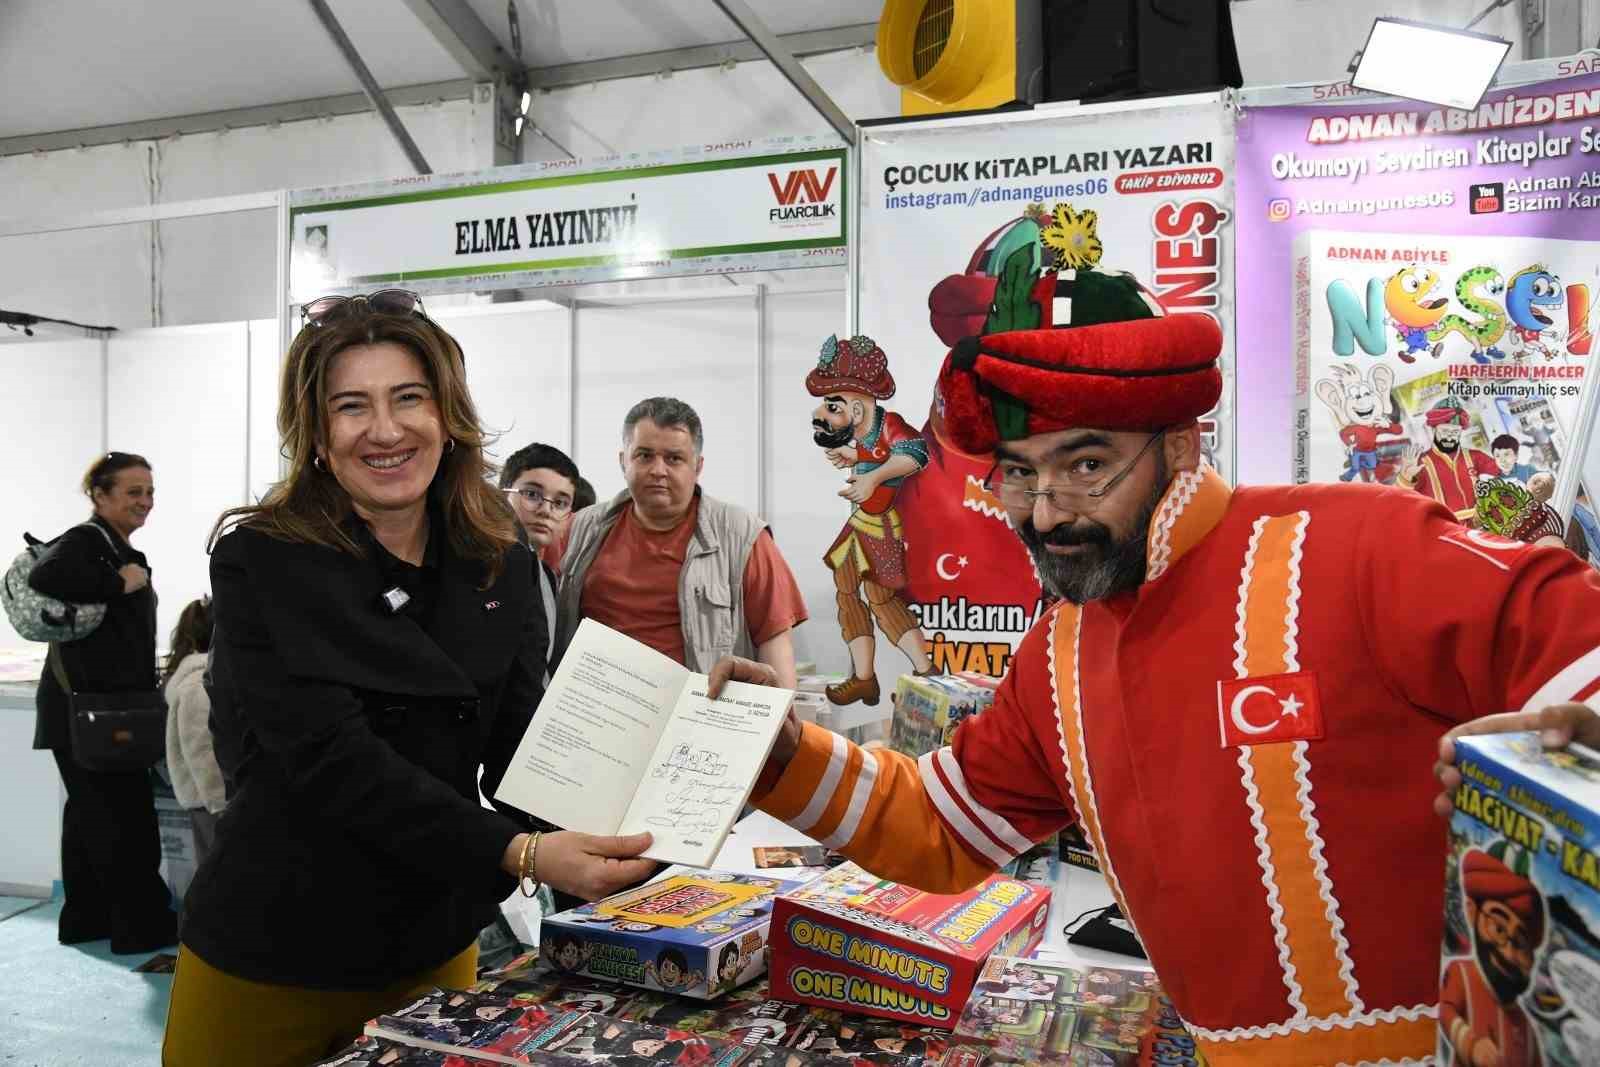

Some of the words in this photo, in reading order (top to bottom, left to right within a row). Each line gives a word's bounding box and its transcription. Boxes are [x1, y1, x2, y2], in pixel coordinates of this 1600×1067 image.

[1306, 112, 1419, 143] ADNAN
[884, 162, 970, 192] ÇOCUK
[1113, 142, 1213, 170] YAZARI
[1271, 152, 1368, 183] Okumayı
[1375, 144, 1470, 175] Sevdiren
[1476, 130, 1572, 167] Kitaplar
[1120, 174, 1154, 190] TAKİP
[1157, 171, 1216, 187] EDİYORUZ
[1478, 185, 1495, 198] You
[1504, 175, 1571, 195] Adnan
[769, 204, 836, 221] FUARCILIK
[1504, 193, 1562, 213] Bizim
[455, 216, 521, 255] ELMA
[1154, 200, 1227, 312] NEŞ
[1326, 246, 1387, 261] ADNAN
[1391, 246, 1449, 263] ABİYLE
[1448, 362, 1529, 378] HARFLERİN
[1533, 366, 1585, 379] MACER
[1447, 382, 1480, 397] Kitap
[1483, 383, 1535, 399] okumayı
[1538, 383, 1557, 400] hiç
[1563, 839, 1600, 890] KA
[792, 920, 845, 957] ONE
[849, 939, 949, 992] MINUTE
[792, 968, 846, 999] ONE
[851, 980, 950, 1019] MINUTE
